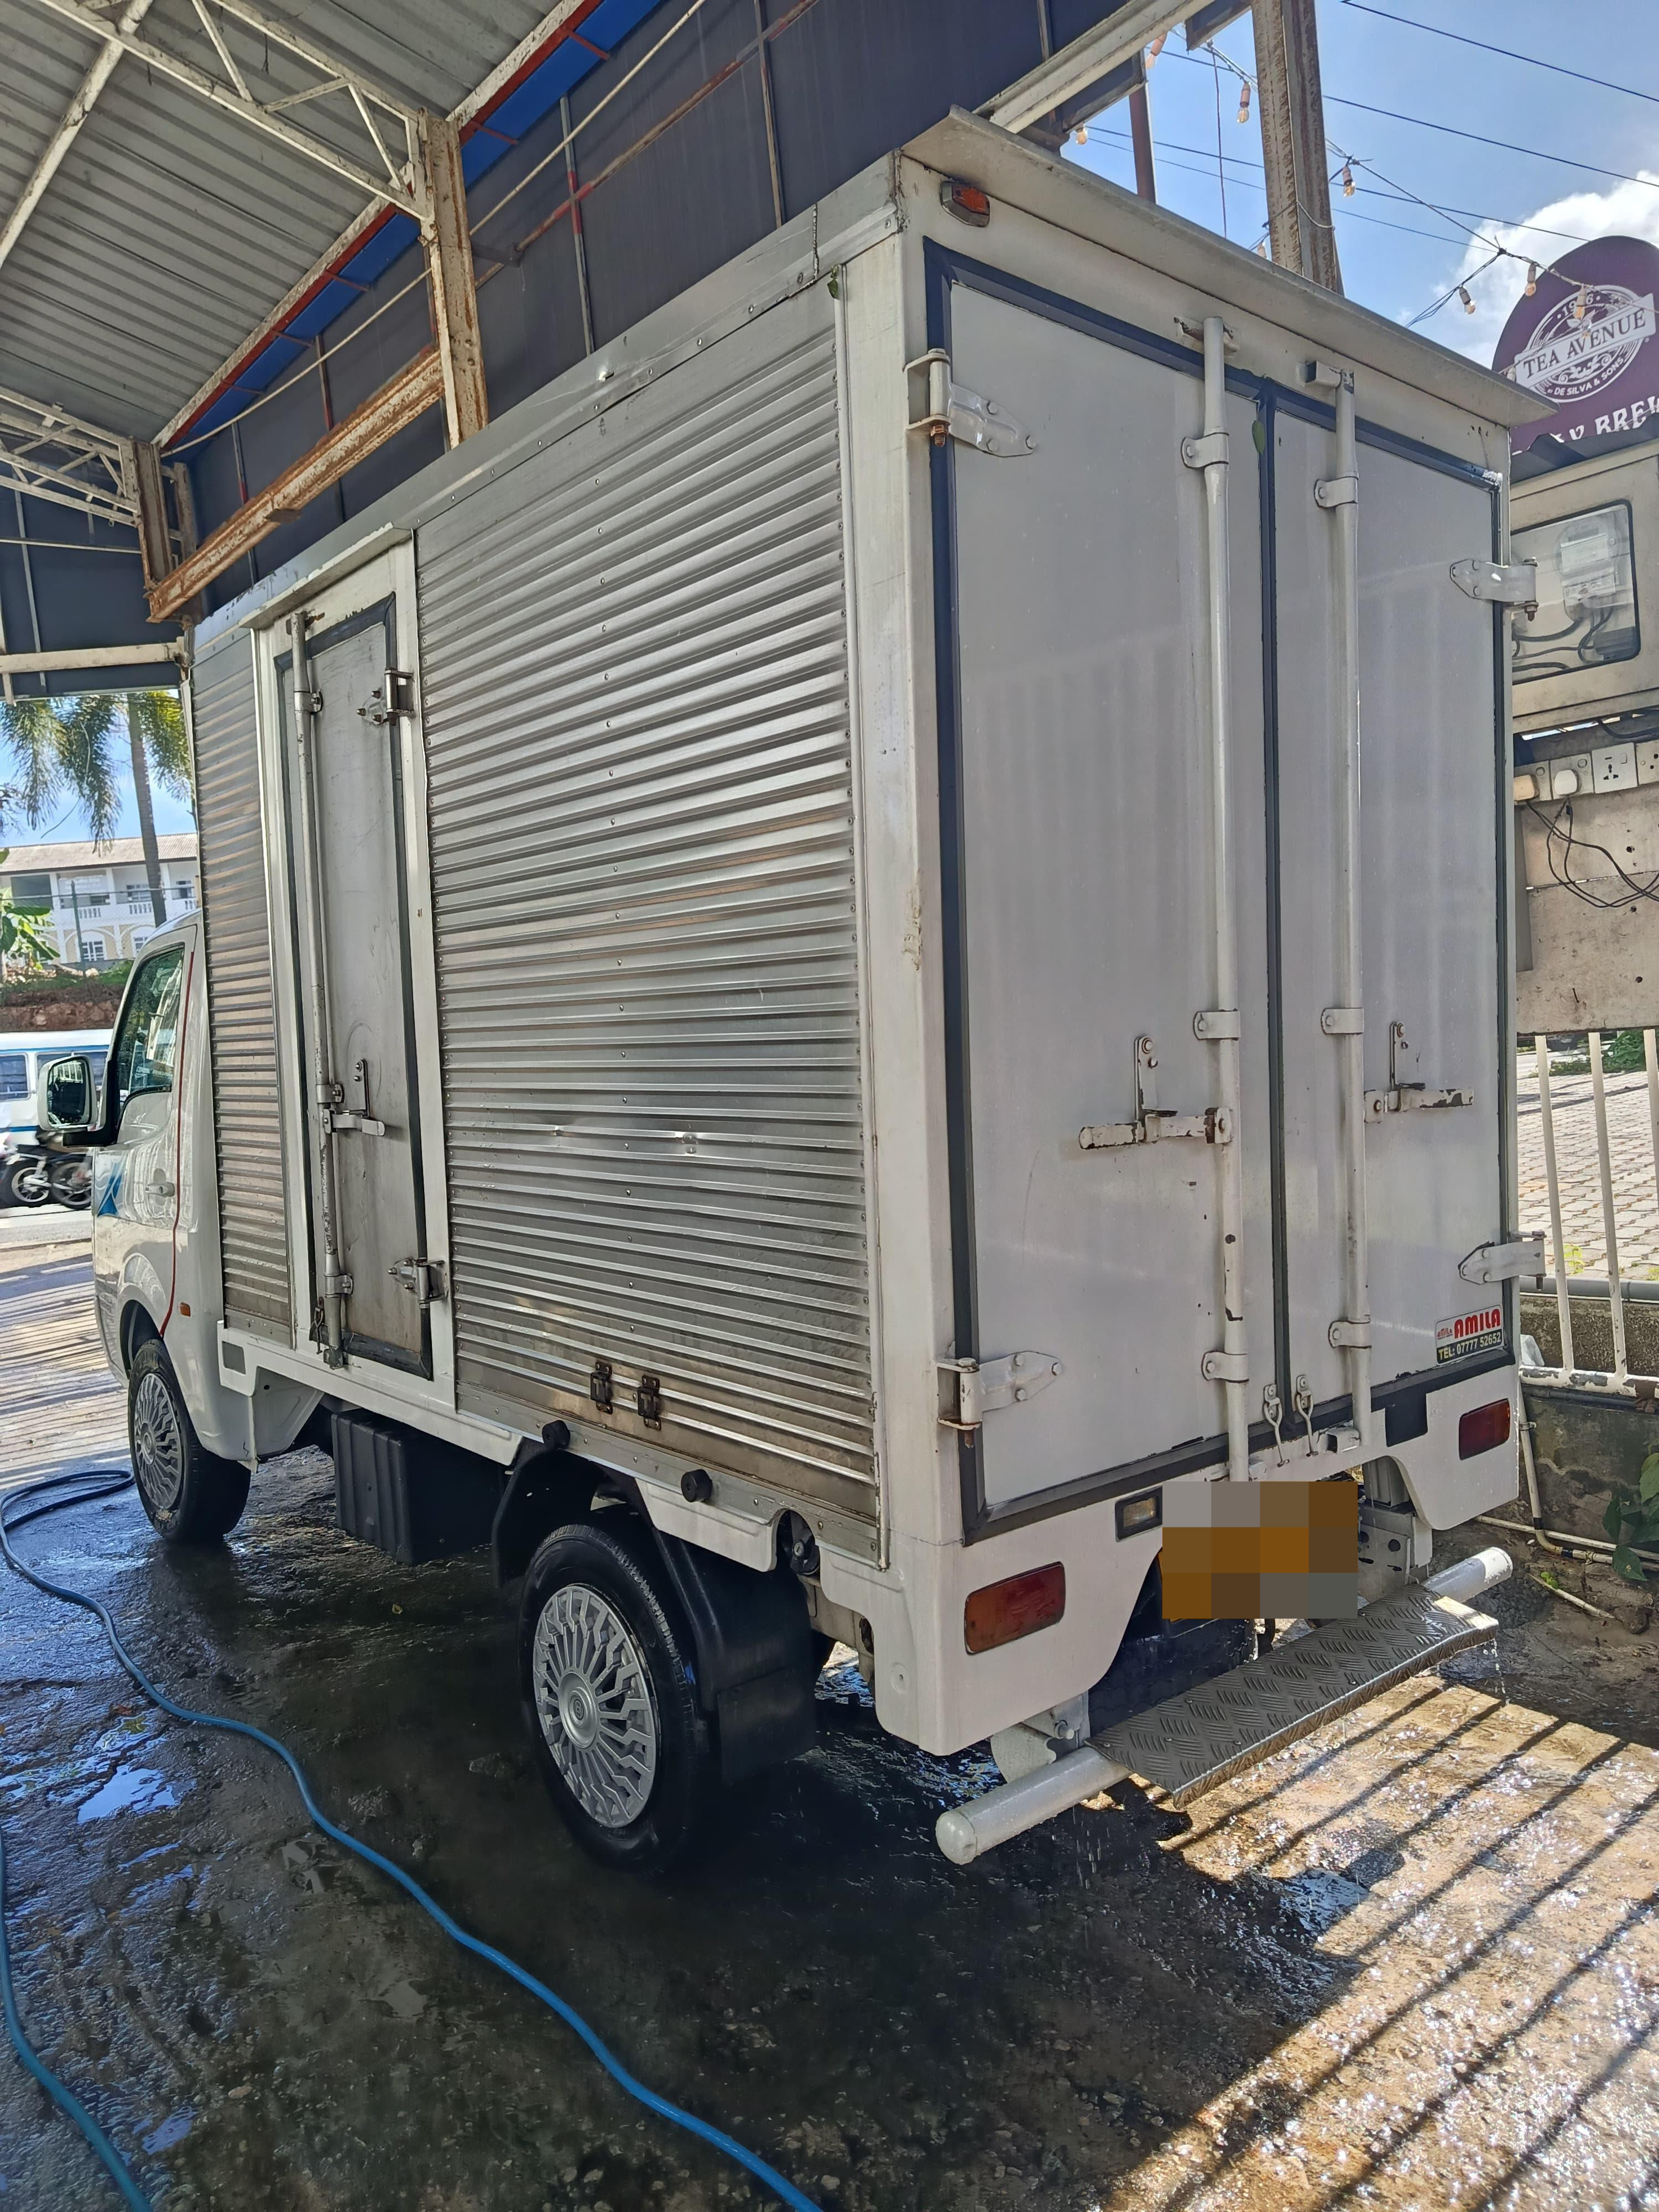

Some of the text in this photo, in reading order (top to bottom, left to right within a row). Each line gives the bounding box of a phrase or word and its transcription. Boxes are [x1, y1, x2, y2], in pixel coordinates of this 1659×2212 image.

[1562, 294, 1594, 316] 196
[1523, 307, 1646, 379] TEA AVENUE
[1554, 387, 1565, 395] DE
[1566, 383, 1593, 396] SILVA
[1601, 356, 1624, 380] SONS
[1454, 1308, 1501, 1339] AMILA
[1438, 1332, 1501, 1360] TEL: 07777 52652
